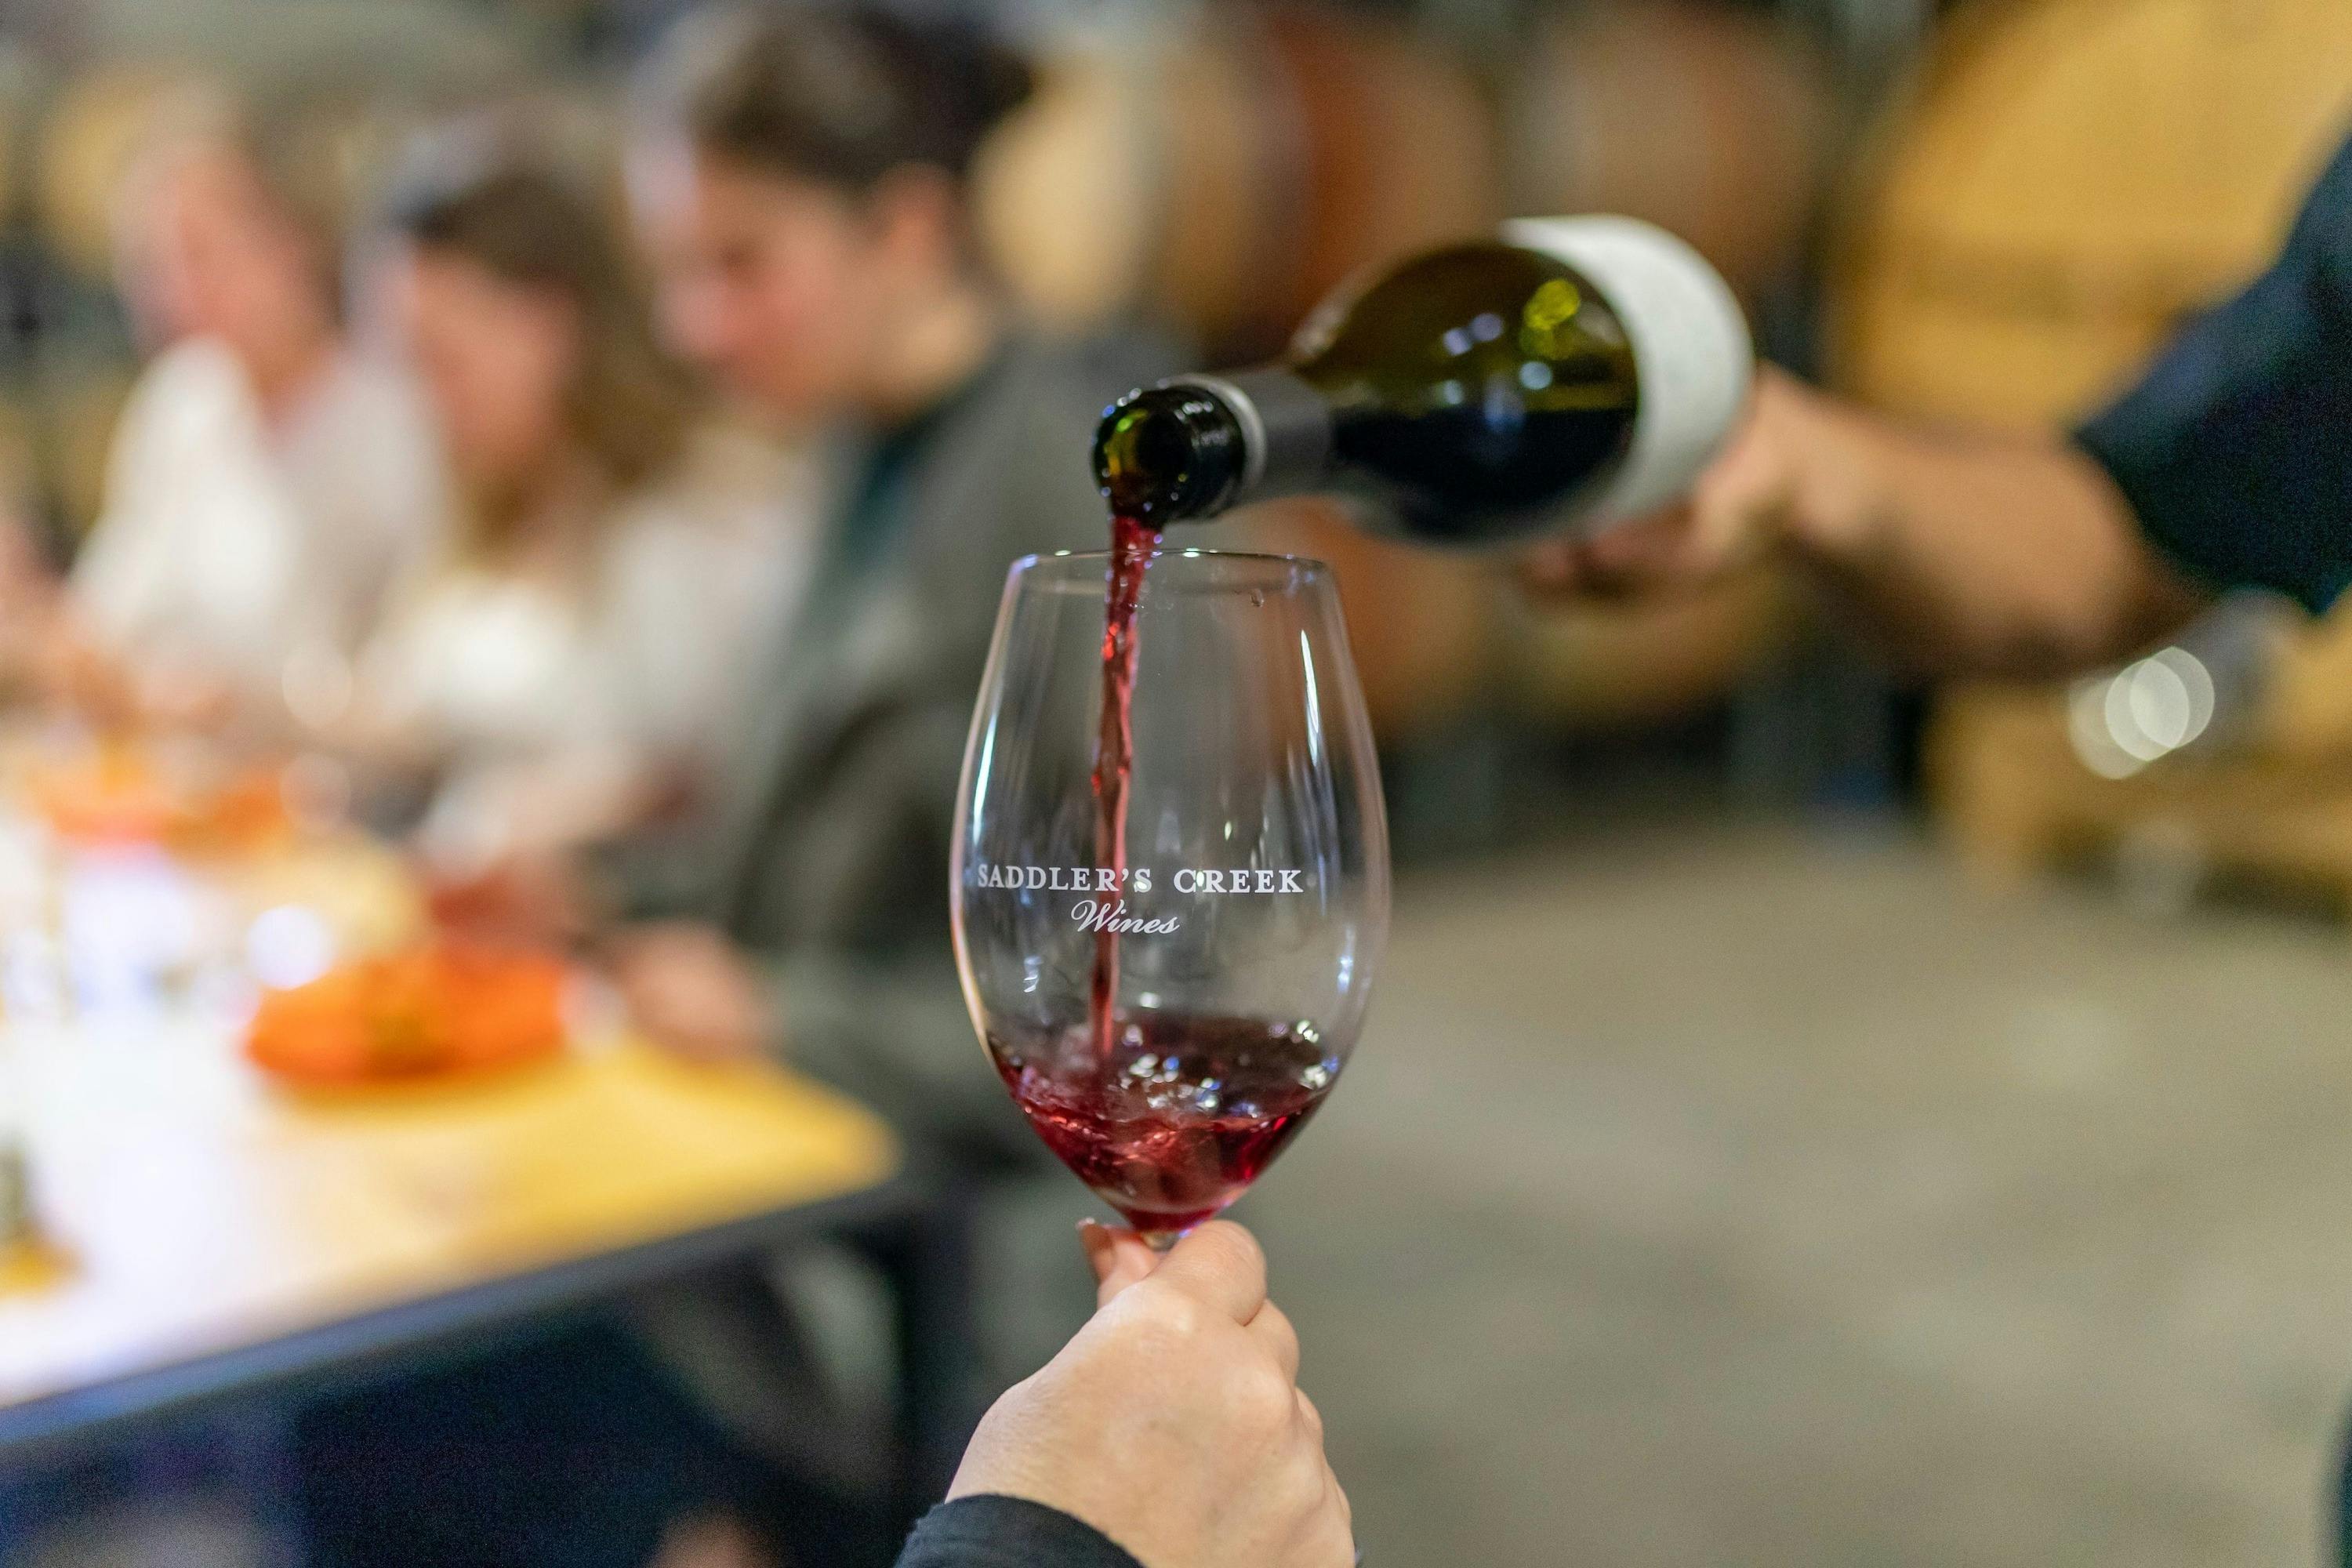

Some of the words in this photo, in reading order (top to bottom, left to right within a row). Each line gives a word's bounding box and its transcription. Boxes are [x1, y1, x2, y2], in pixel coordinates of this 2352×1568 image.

[977, 863, 1152, 894] SADDLER'S
[1173, 868, 1305, 894] CREEK
[1070, 898, 1181, 935] Wines
